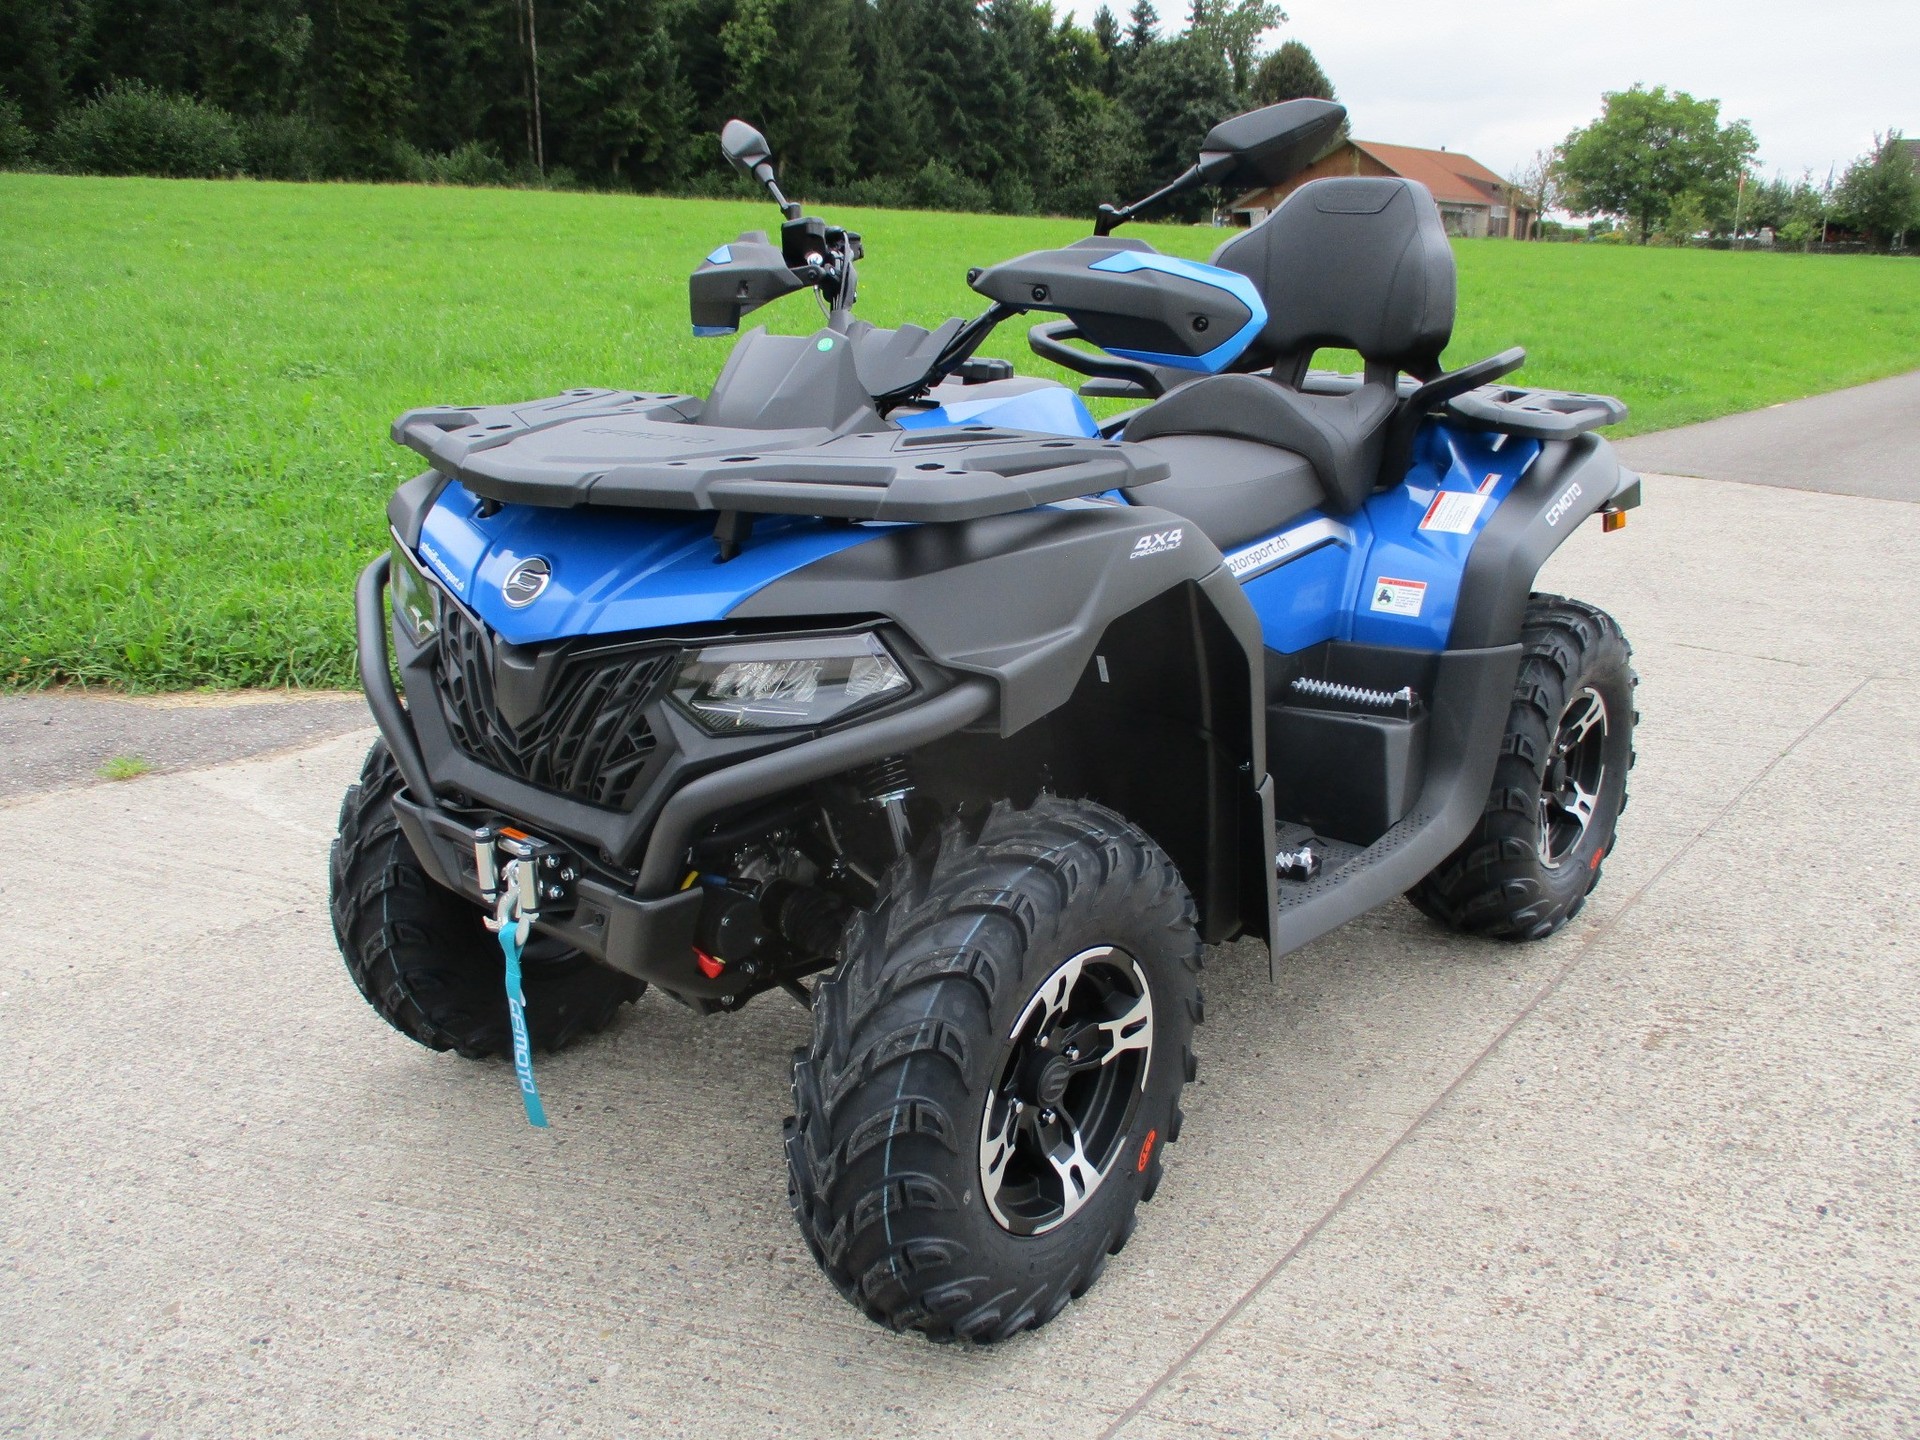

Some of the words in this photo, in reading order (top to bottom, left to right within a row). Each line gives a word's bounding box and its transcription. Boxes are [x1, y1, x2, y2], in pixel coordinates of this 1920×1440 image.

[1545, 482, 1583, 527] CFMOTO
[1228, 535, 1290, 573] otorsport.ch
[508, 997, 536, 1094] CFMOTO
